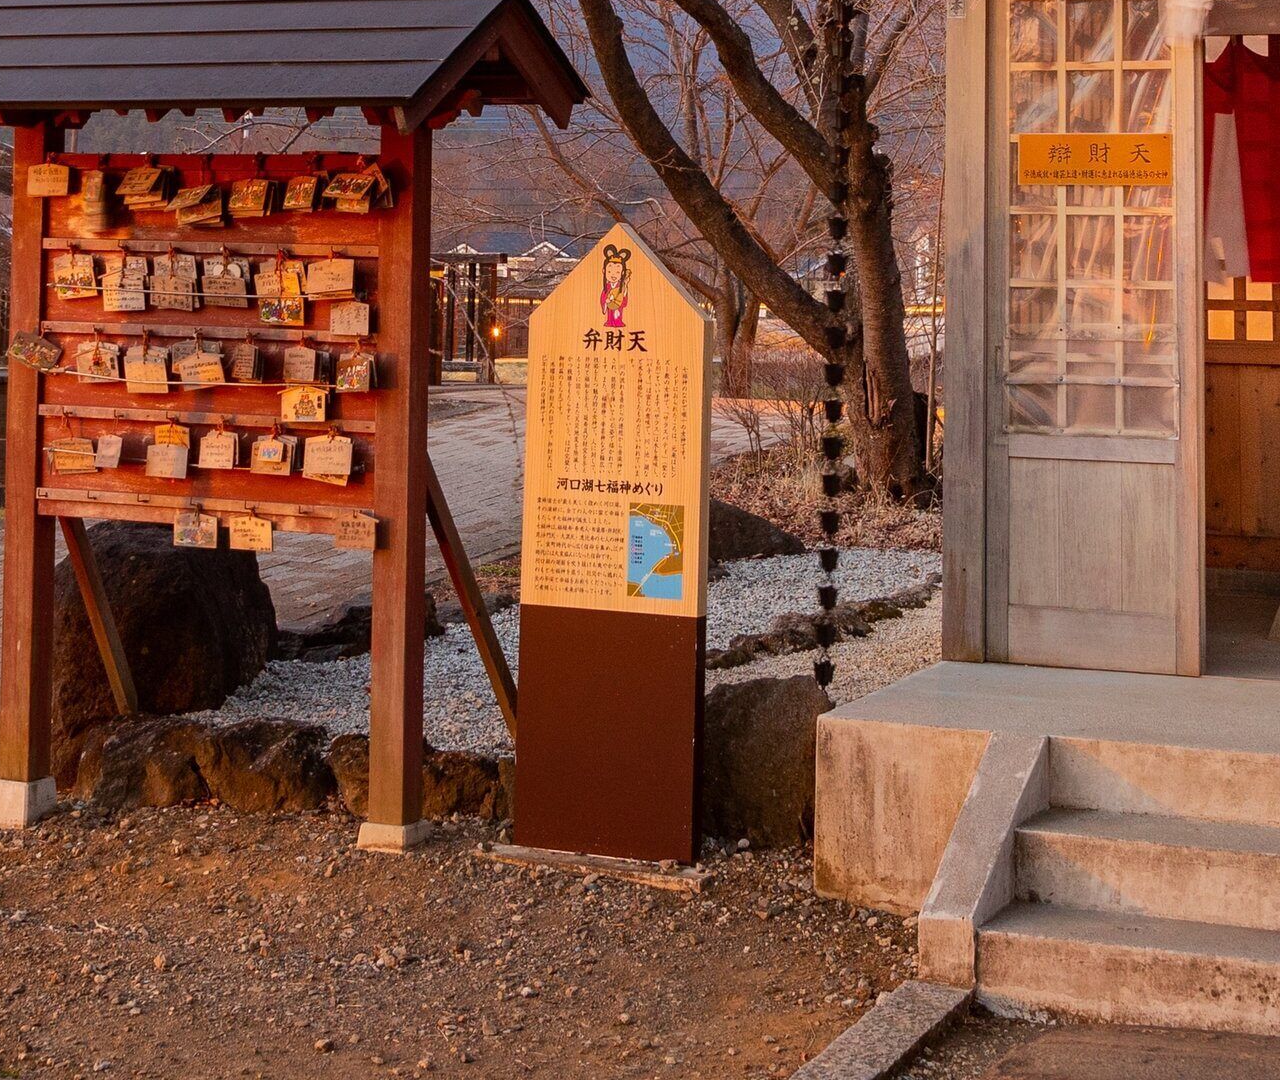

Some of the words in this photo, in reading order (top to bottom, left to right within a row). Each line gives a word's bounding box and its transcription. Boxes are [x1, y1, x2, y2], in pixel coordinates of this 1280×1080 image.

[582, 328, 648, 352] 弁財天
[556, 477, 663, 496] 河口湖七福神めぐり
